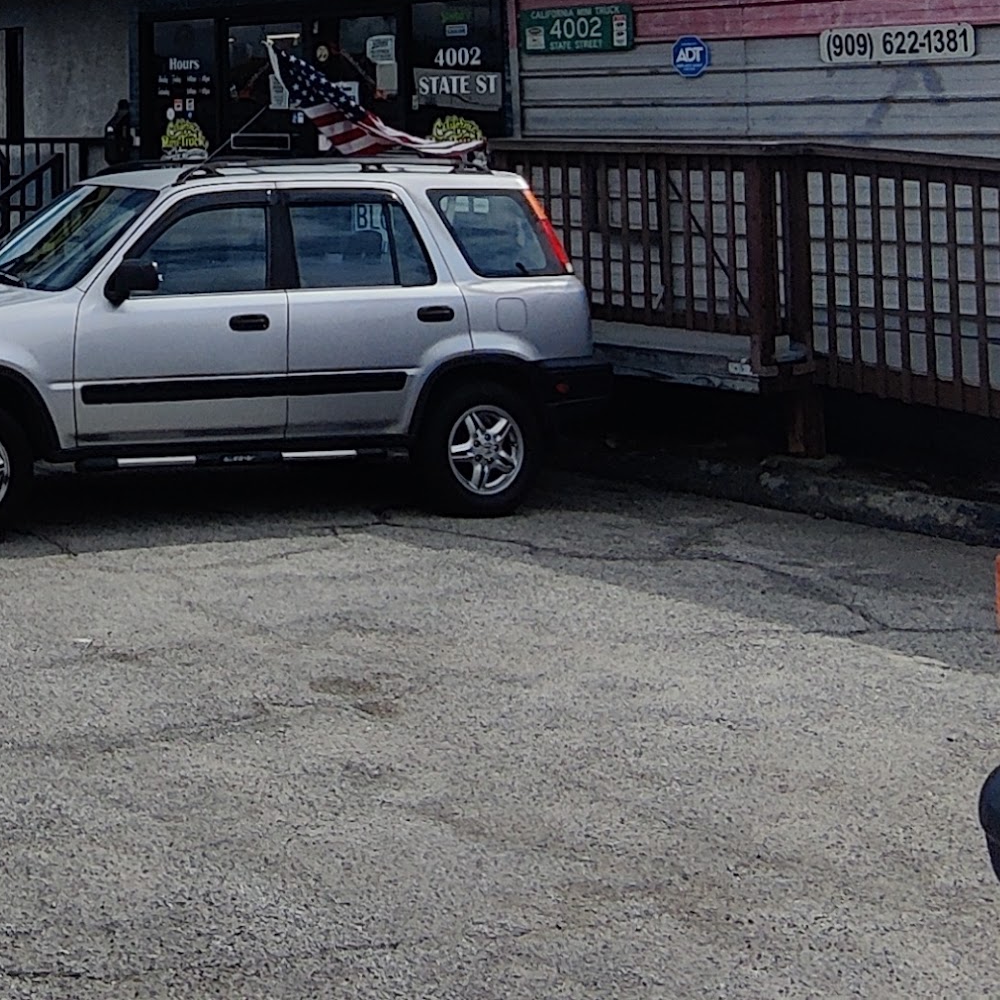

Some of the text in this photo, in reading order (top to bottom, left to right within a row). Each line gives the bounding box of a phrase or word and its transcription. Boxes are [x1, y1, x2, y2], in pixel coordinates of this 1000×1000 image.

[595, 5, 620, 15] TRUCK
[549, 16, 602, 39] 4002
[549, 38, 603, 51] STATE STREET
[826, 27, 969, 61] (909) 622-1381
[168, 57, 201, 71] Hours
[434, 46, 481, 67] 4002
[675, 46, 704, 63] ADT
[419, 74, 498, 96] STATE ST
